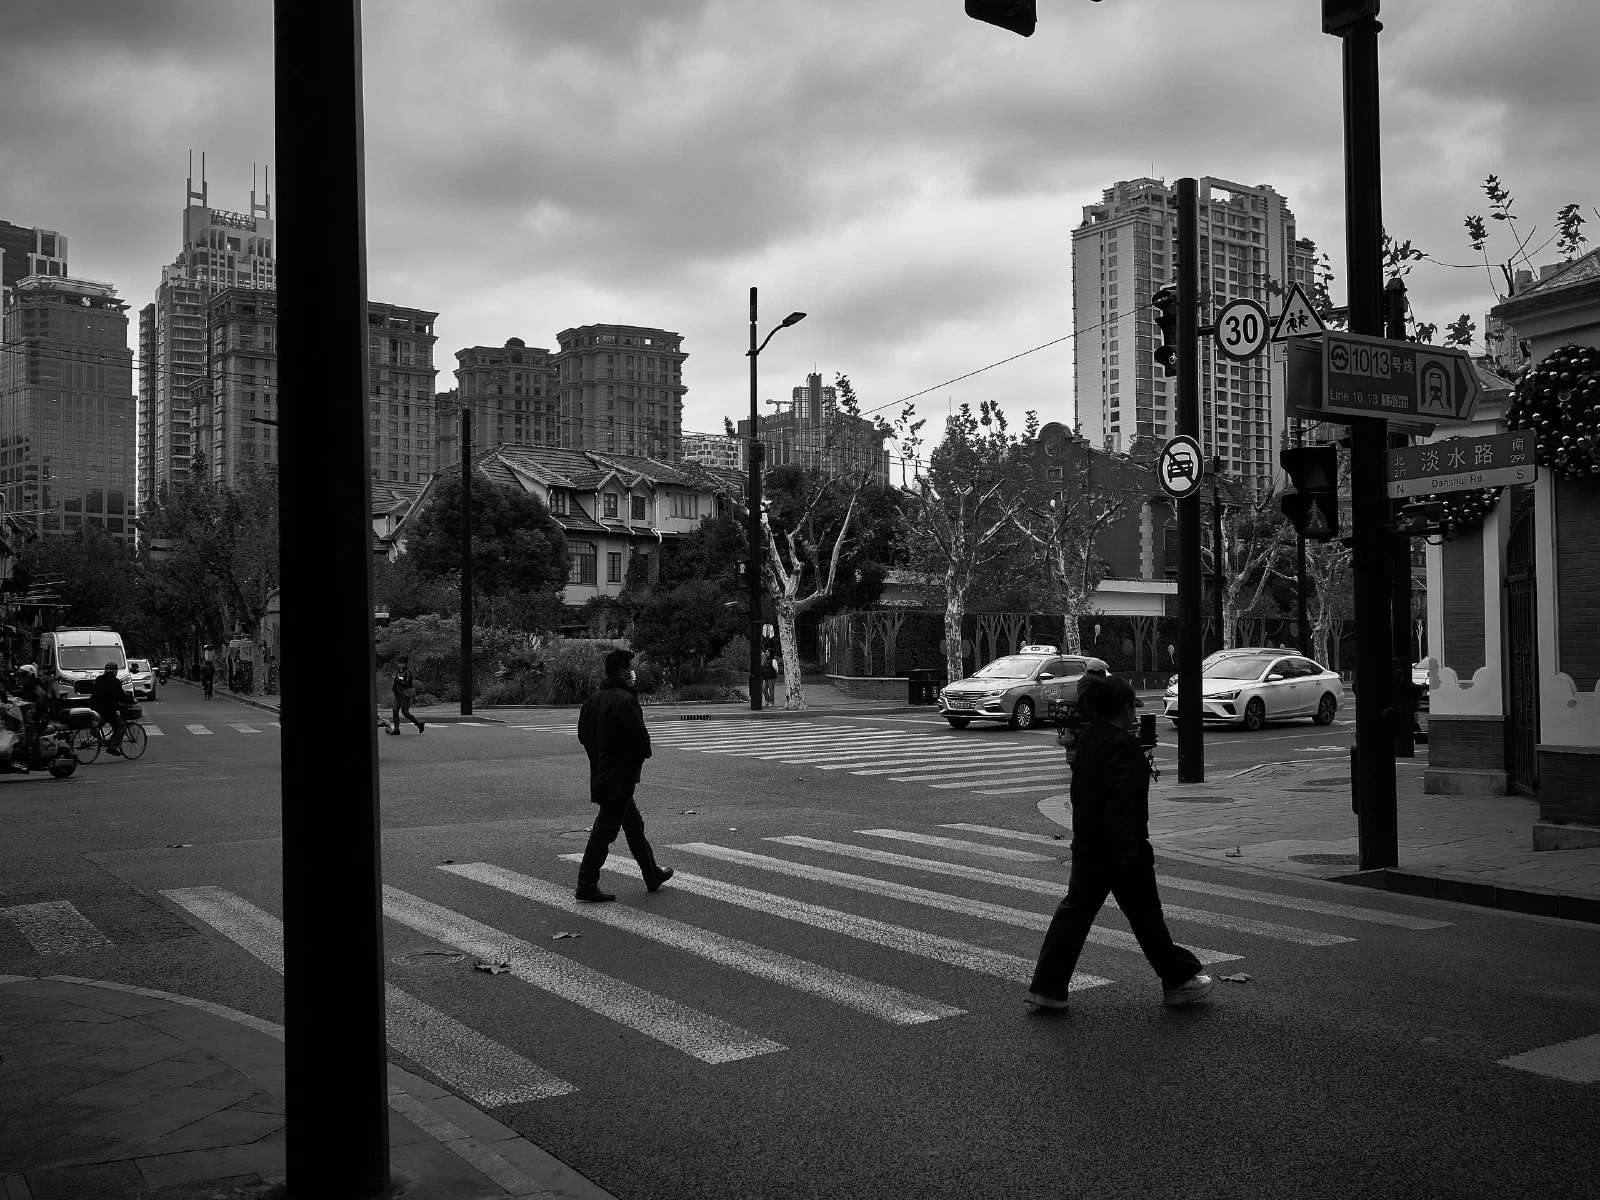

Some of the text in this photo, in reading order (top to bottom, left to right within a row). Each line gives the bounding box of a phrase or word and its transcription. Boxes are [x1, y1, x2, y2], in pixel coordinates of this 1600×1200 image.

[1225, 313, 1258, 346] 30
[1330, 388, 1349, 402] Line
[1383, 395, 1408, 408] 150m
[1512, 437, 1524, 451] 南
[1394, 454, 1405, 467] 北
[1421, 443, 1494, 472] 淡水路
[1510, 453, 1526, 463] 299
[1431, 474, 1486, 488] Danshui Rd.
[1516, 469, 1524, 480] S
[1396, 483, 1404, 494] N
